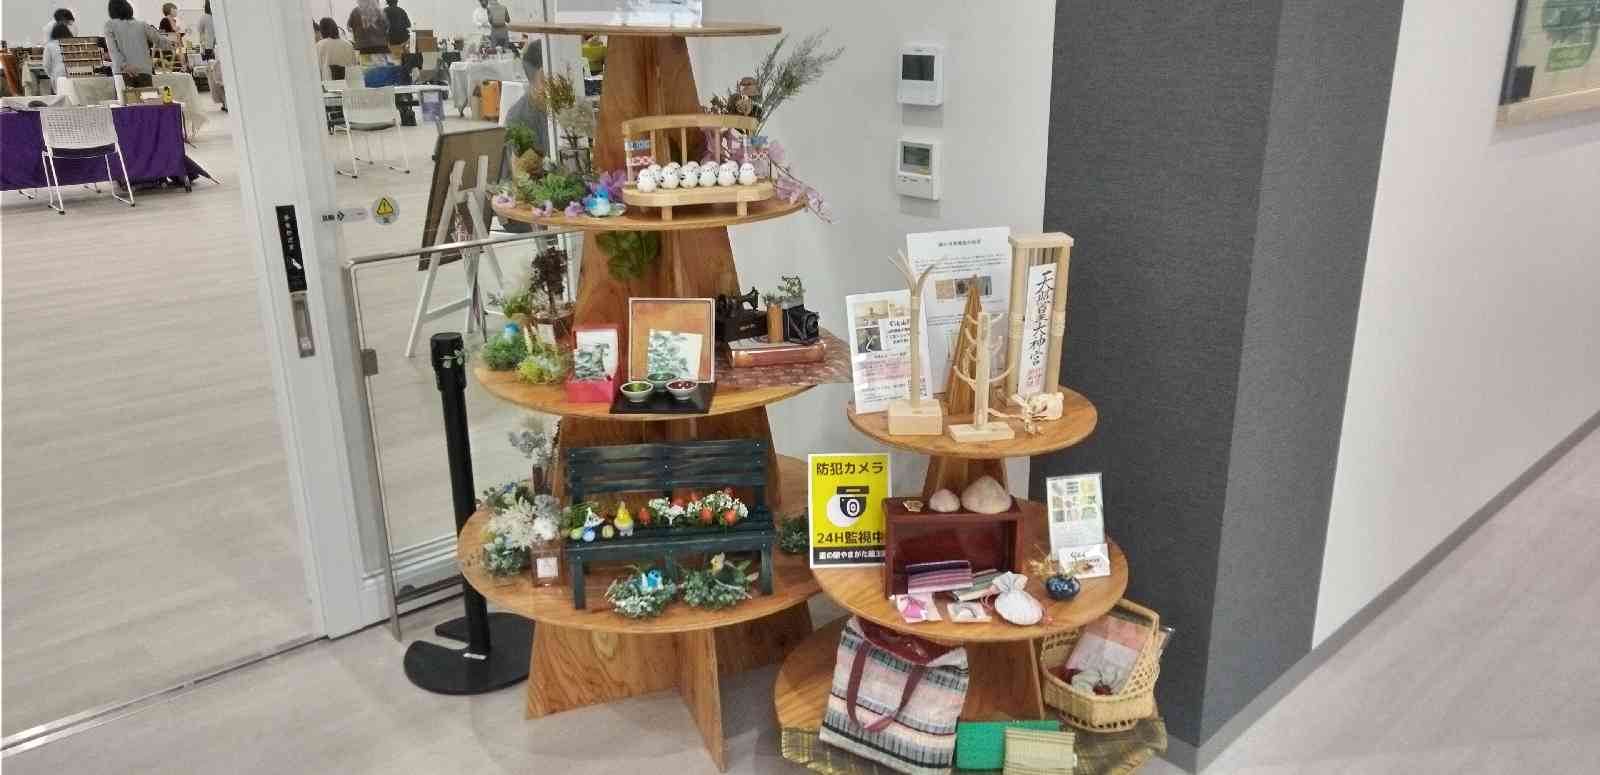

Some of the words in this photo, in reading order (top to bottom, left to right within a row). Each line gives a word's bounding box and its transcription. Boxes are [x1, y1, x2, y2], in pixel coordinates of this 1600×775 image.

[817, 462, 884, 476] 防犯カメラ
